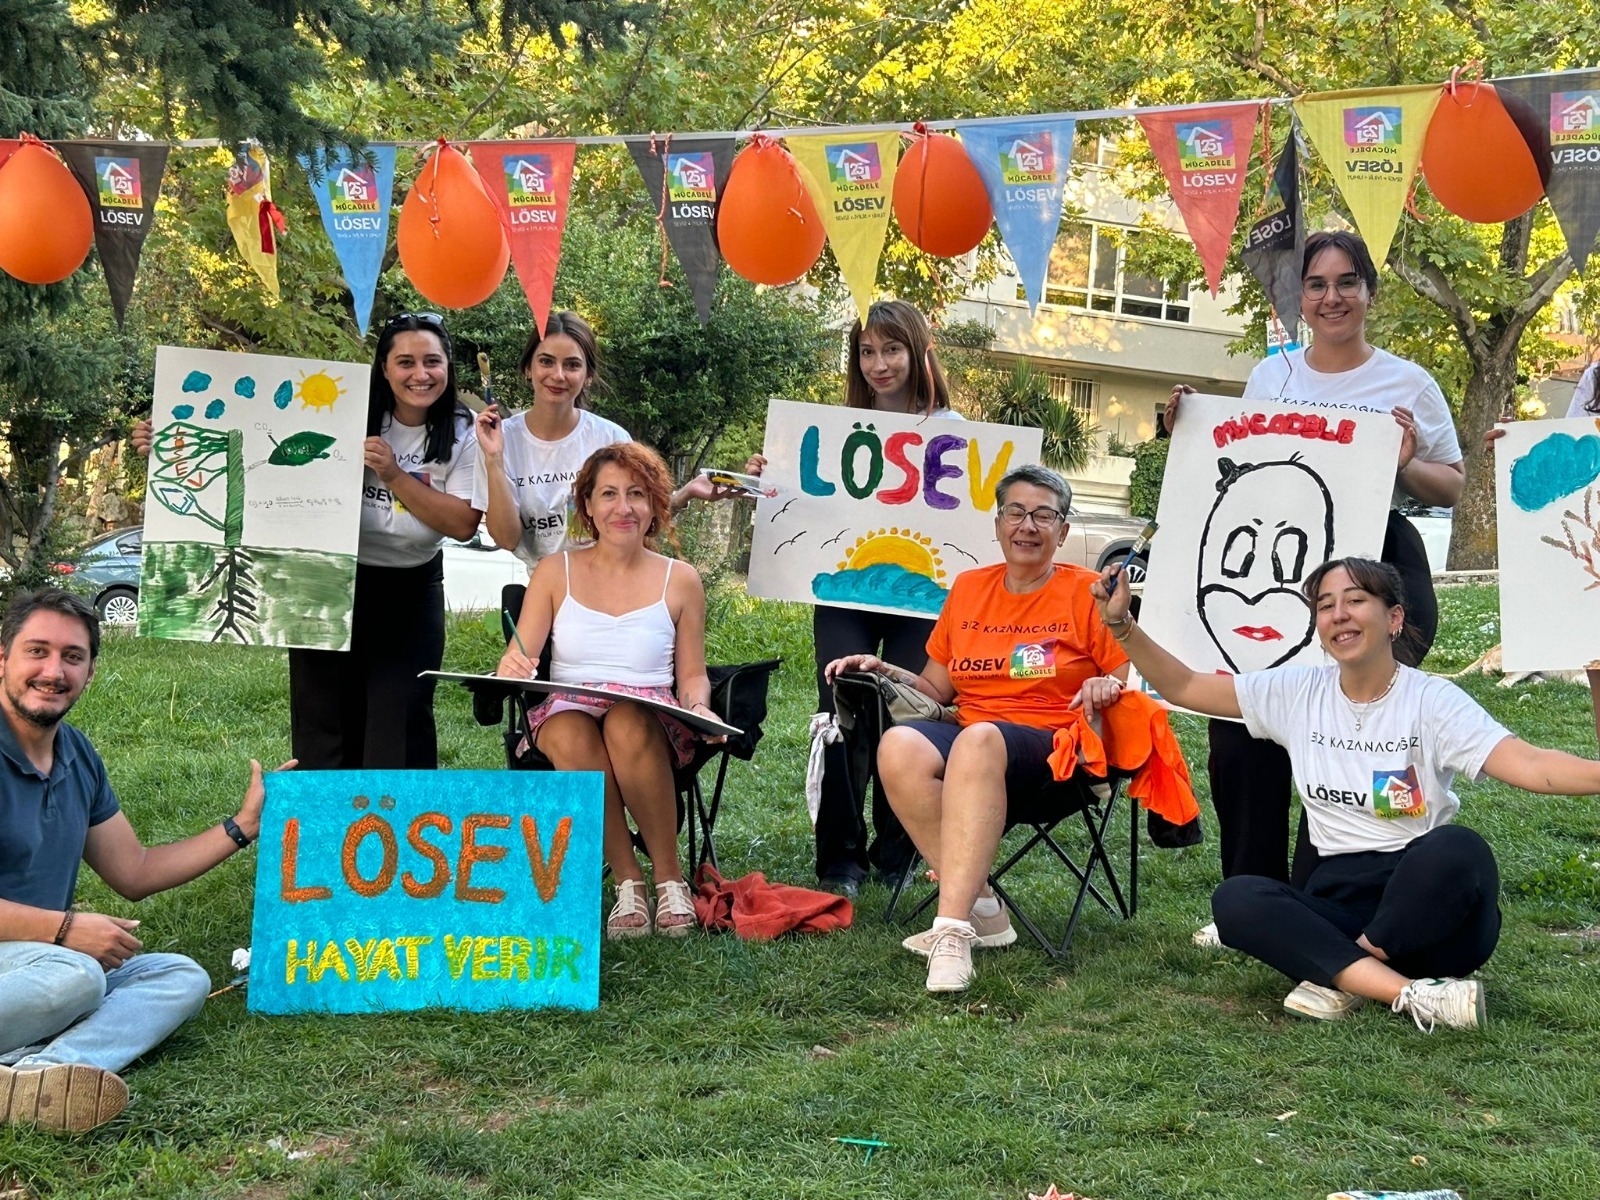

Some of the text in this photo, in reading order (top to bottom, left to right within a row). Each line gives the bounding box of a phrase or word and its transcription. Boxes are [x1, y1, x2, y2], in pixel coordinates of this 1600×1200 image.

[1201, 139, 1216, 152] 25
[1022, 152, 1038, 166] 25
[686, 169, 700, 183] 25
[850, 163, 864, 177] 25
[115, 175, 128, 190] 25
[526, 173, 539, 187] 25
[1183, 172, 1238, 187] LÖSEV
[349, 181, 361, 197] 25
[1005, 188, 1056, 203] LÖSEV
[672, 204, 715, 220] LÖSEV
[833, 196, 885, 213] LÖSEV
[100, 210, 143, 226] LÖSEV
[510, 206, 557, 224] LÖSEV
[333, 216, 381, 231] LÖSEV
[1213, 411, 1357, 448] MÜCADELE
[799, 421, 1014, 513] LÖSEV
[951, 658, 1006, 672] LÖSEV
[1307, 784, 1367, 807] LÖSEV
[1394, 790, 1410, 805] 25
[281, 795, 573, 904] LÖSEV
[286, 936, 434, 984] HAYAT
